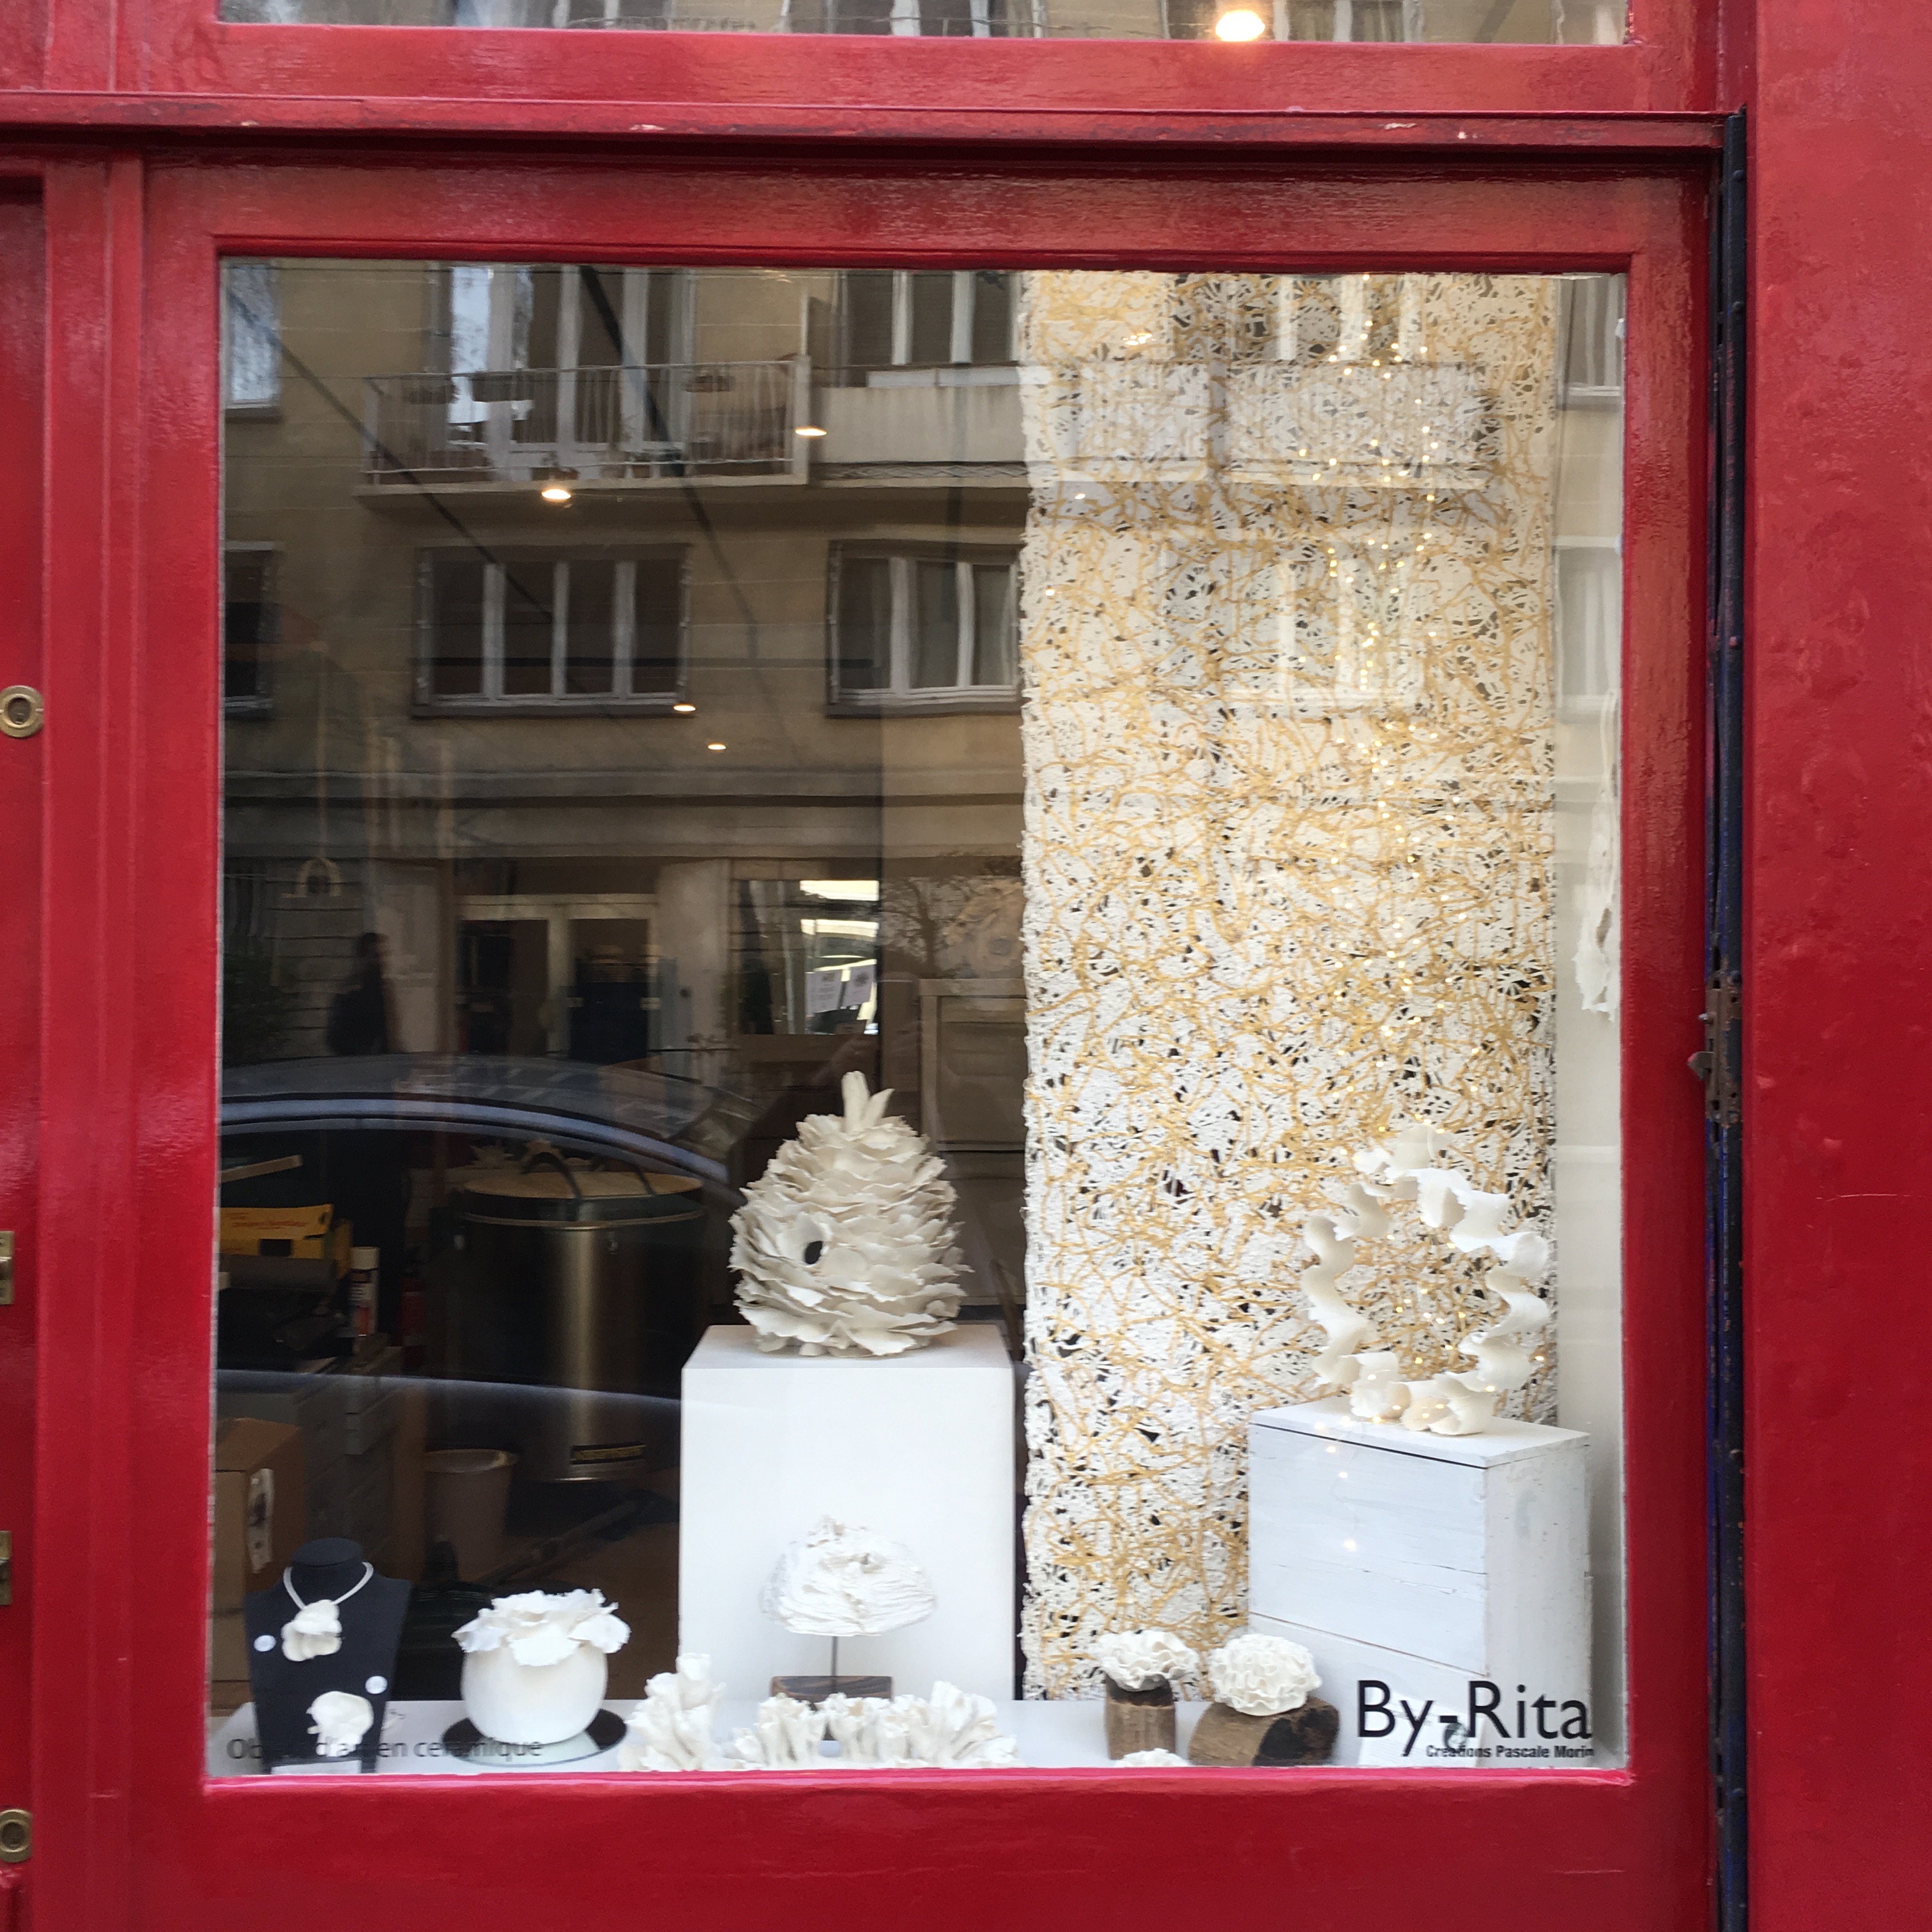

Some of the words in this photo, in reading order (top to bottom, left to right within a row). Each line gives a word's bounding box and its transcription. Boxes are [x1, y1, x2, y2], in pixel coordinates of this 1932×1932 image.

[1358, 1679, 1593, 1757] By-Rita
[377, 1742, 409, 1758] en
[1495, 1745, 1551, 1758] Pascale
